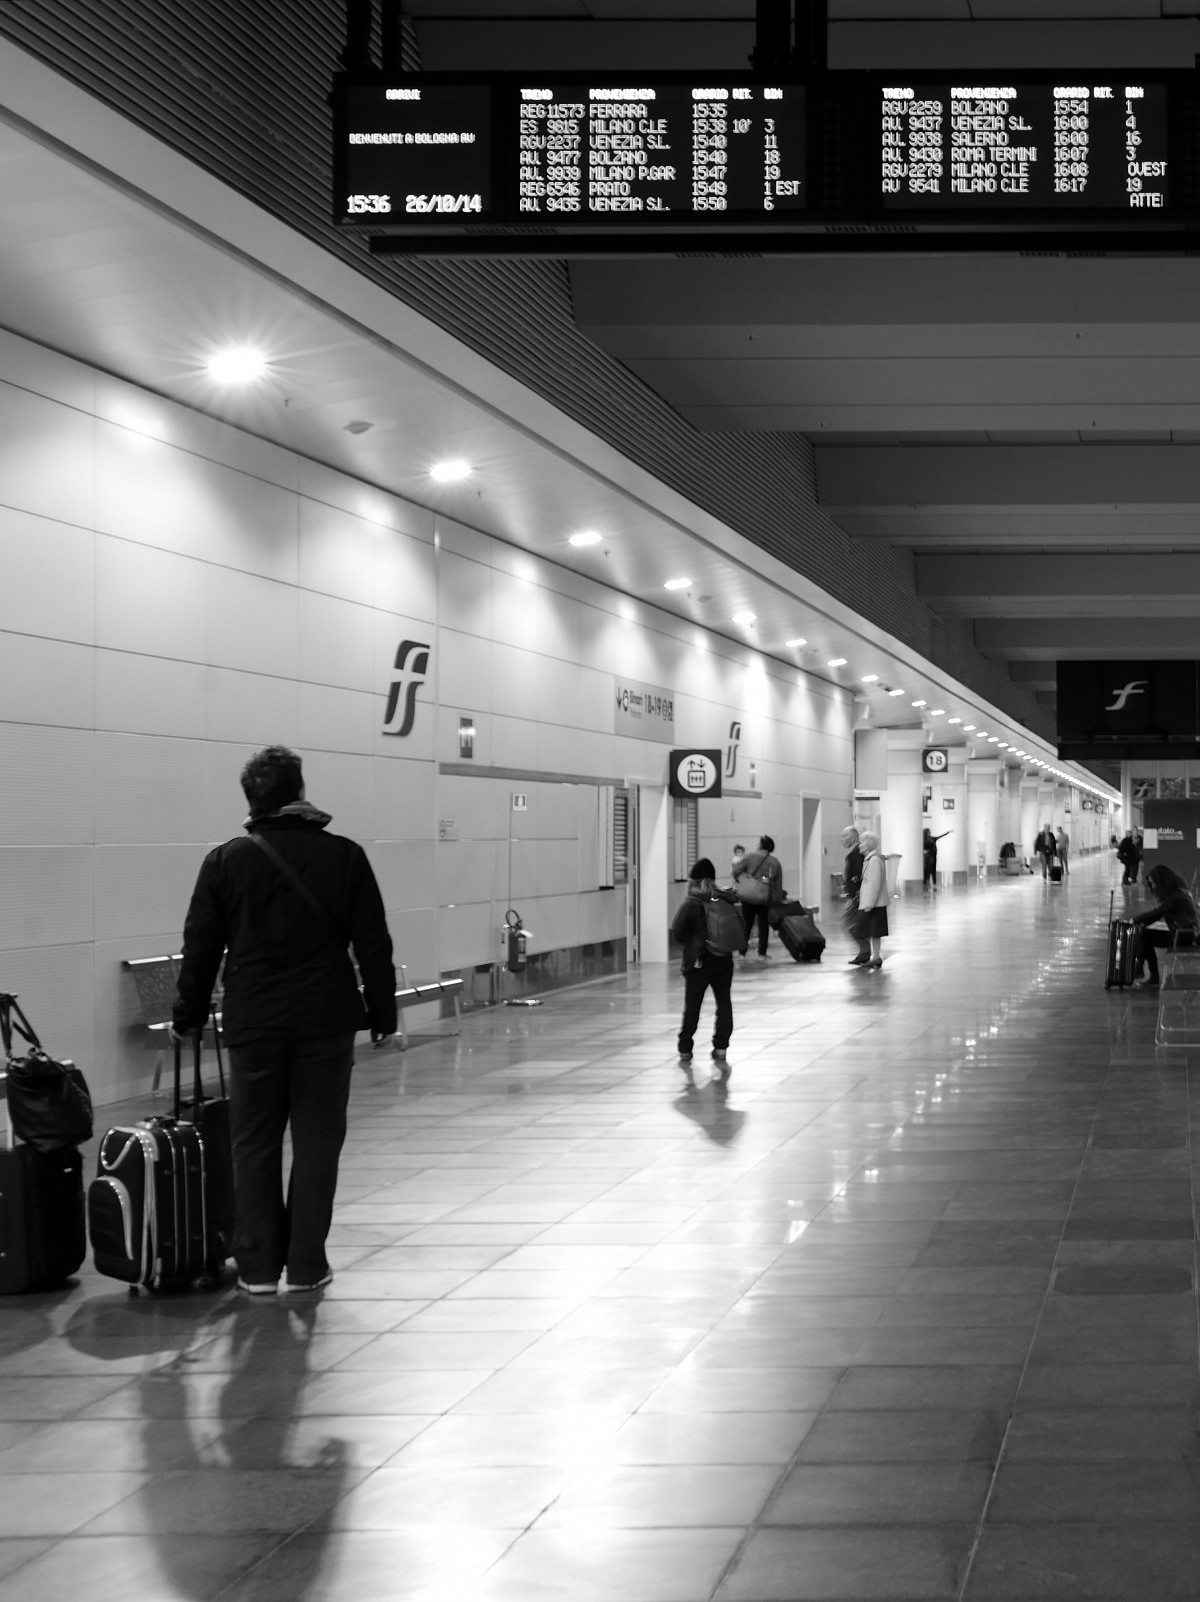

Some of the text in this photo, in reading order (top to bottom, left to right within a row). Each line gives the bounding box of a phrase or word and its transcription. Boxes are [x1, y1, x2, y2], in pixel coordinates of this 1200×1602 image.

[590, 103, 727, 119] FERRARA 15:35
[951, 100, 1009, 115] BOLZANO
[1054, 100, 1089, 114] 15:54
[520, 119, 538, 134] ES
[547, 119, 579, 134] 9815
[590, 119, 635, 134] MILANO
[692, 119, 727, 134] 15:38
[764, 119, 775, 133] 3
[909, 116, 943, 131] 9437
[951, 116, 1005, 130] VENEZIA
[1054, 115, 1089, 130] 16:00
[1126, 115, 1136, 129] 4
[405, 133, 413, 145] A
[415, 133, 459, 144] BOLOGNA
[590, 135, 643, 150] VENEZIA
[692, 134, 727, 149] 15:40
[764, 134, 778, 149] 11
[909, 131, 1142, 146] 9938 SALERNO 16:00 16
[547, 150, 781, 165] 9477 BOLZANO 15:40 18
[909, 146, 1136, 162] 9430 ROMA TERMINI 16:07 3
[547, 166, 581, 181] 9939
[589, 166, 635, 181] MILANO
[692, 166, 727, 180] 15:47
[764, 165, 781, 180] 19
[951, 163, 997, 178] MILANO
[1054, 162, 1089, 177] 16:08
[1128, 162, 1167, 176] OVEST
[589, 181, 630, 196] PRATO
[692, 181, 727, 196] 15:49
[776, 181, 801, 195] EST
[909, 178, 940, 193] 9541
[951, 178, 997, 193] MILANO
[1054, 178, 1087, 192] 16:17
[1126, 177, 1142, 192] 19
[347, 194, 482, 213] 15:36 26/10/14
[547, 197, 581, 211] 9435
[589, 197, 643, 211] VENEZIA
[692, 196, 727, 211] 15:50
[764, 196, 774, 210] 6
[1130, 193, 1163, 207] ATTE
[928, 755, 942, 766] 18
